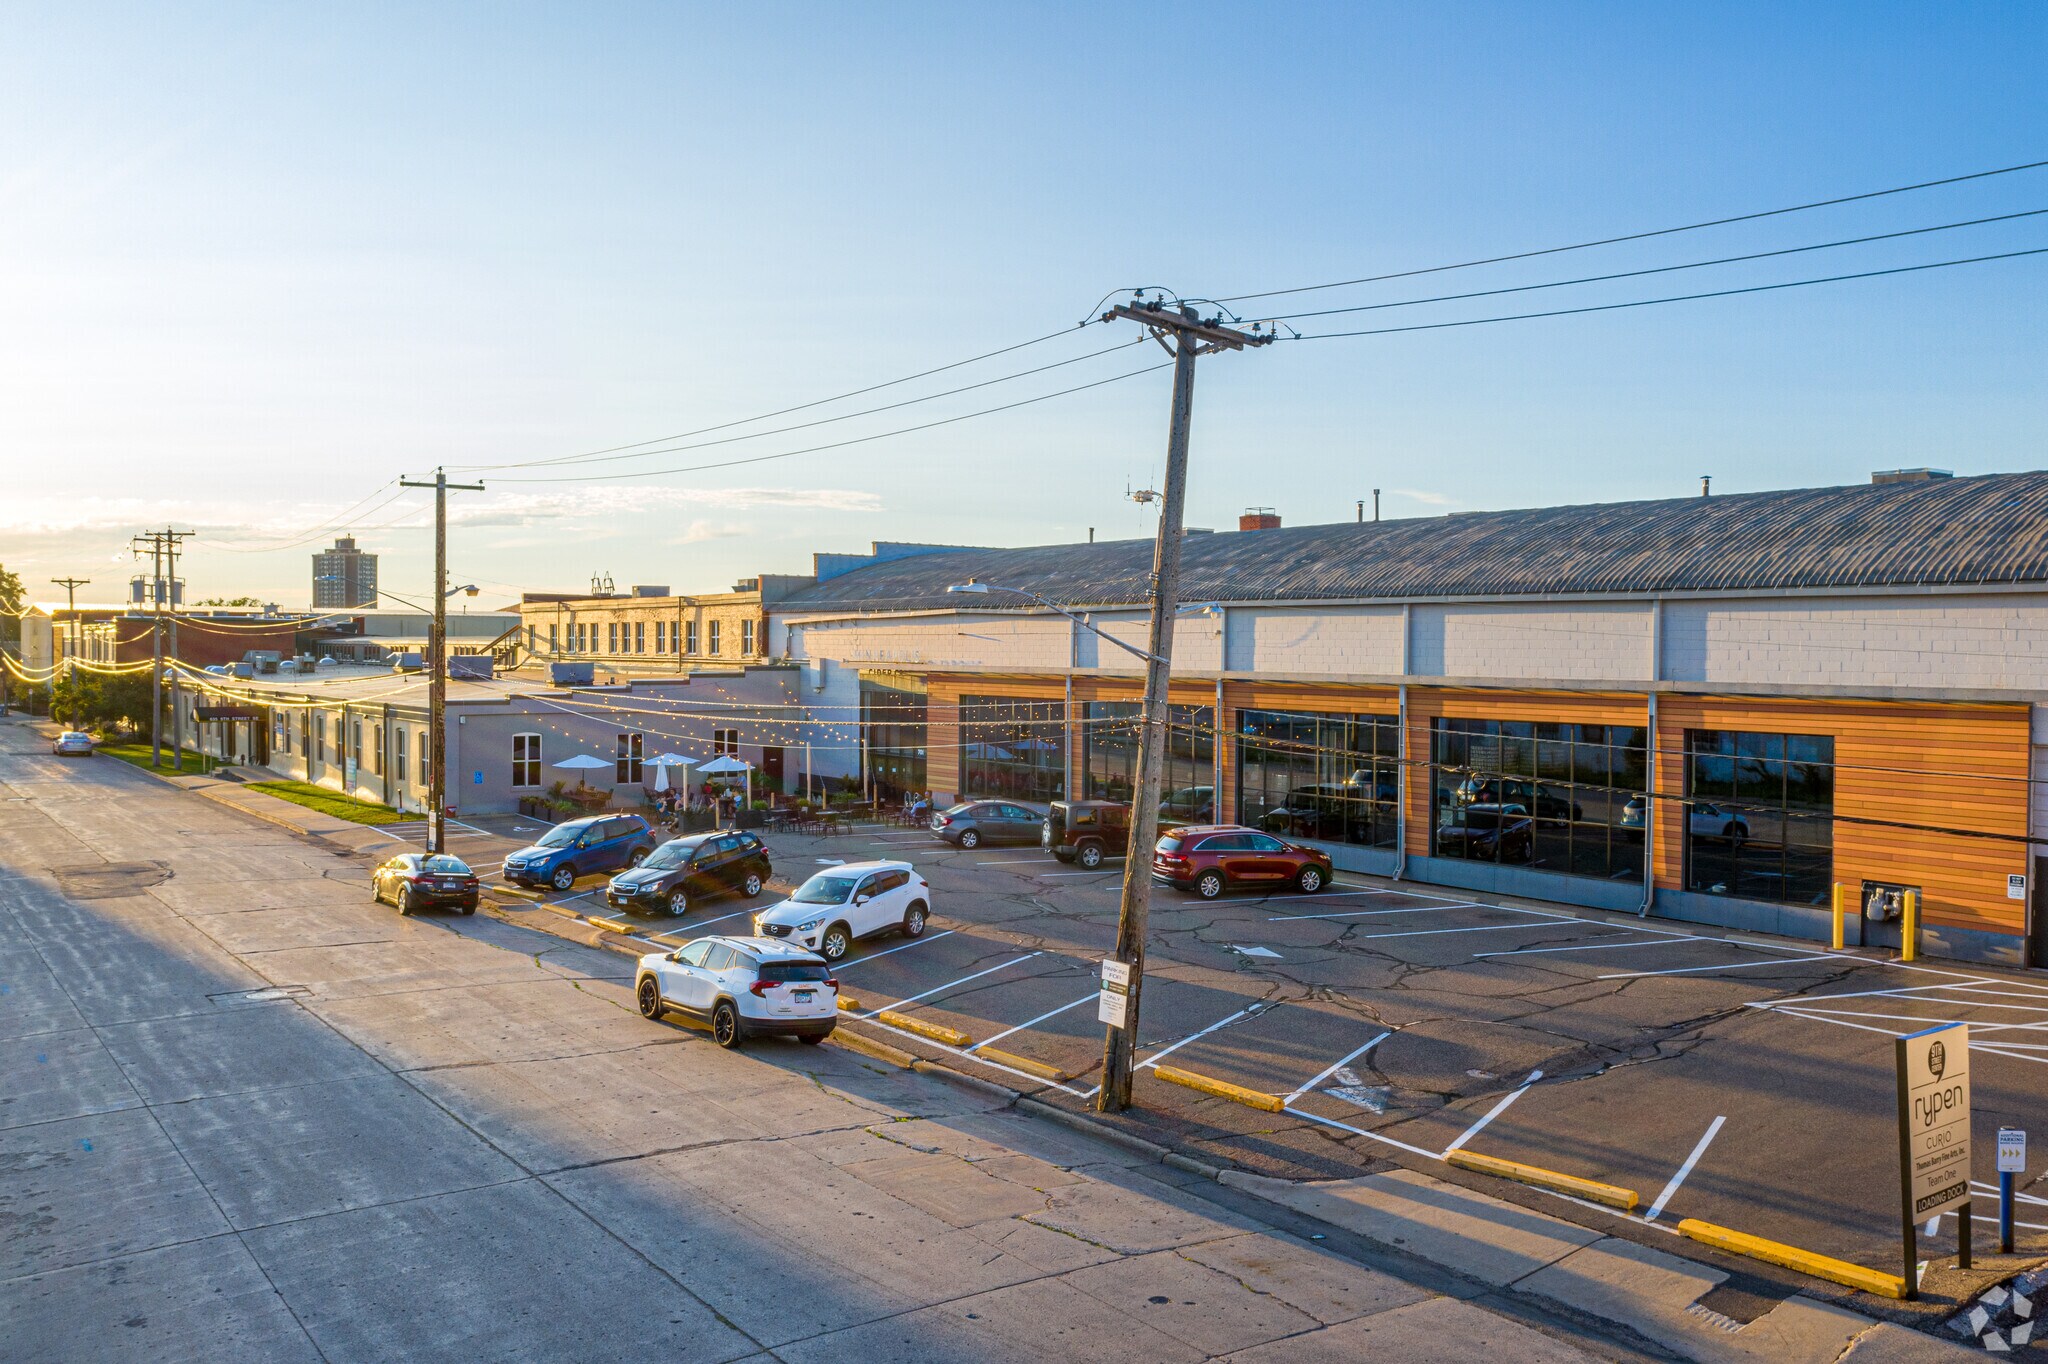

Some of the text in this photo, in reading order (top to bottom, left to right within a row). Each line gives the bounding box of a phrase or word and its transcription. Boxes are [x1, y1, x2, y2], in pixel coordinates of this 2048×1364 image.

[1103, 965, 1128, 976] PARKING
[1106, 994, 1121, 1002] ONLY
[1931, 1043, 1943, 1058] 9TH
[1931, 1056, 1942, 1065] STREET
[1915, 1085, 1963, 1127] rypen
[1926, 1130, 1952, 1149] CURIO
[1916, 1161, 1931, 1171] Thomas
[1931, 1156, 1942, 1166] Barry
[1942, 1151, 1950, 1161] Fine
[1928, 1169, 1957, 1188] Team One
[1918, 1183, 1965, 1211] LOADING DOCK
